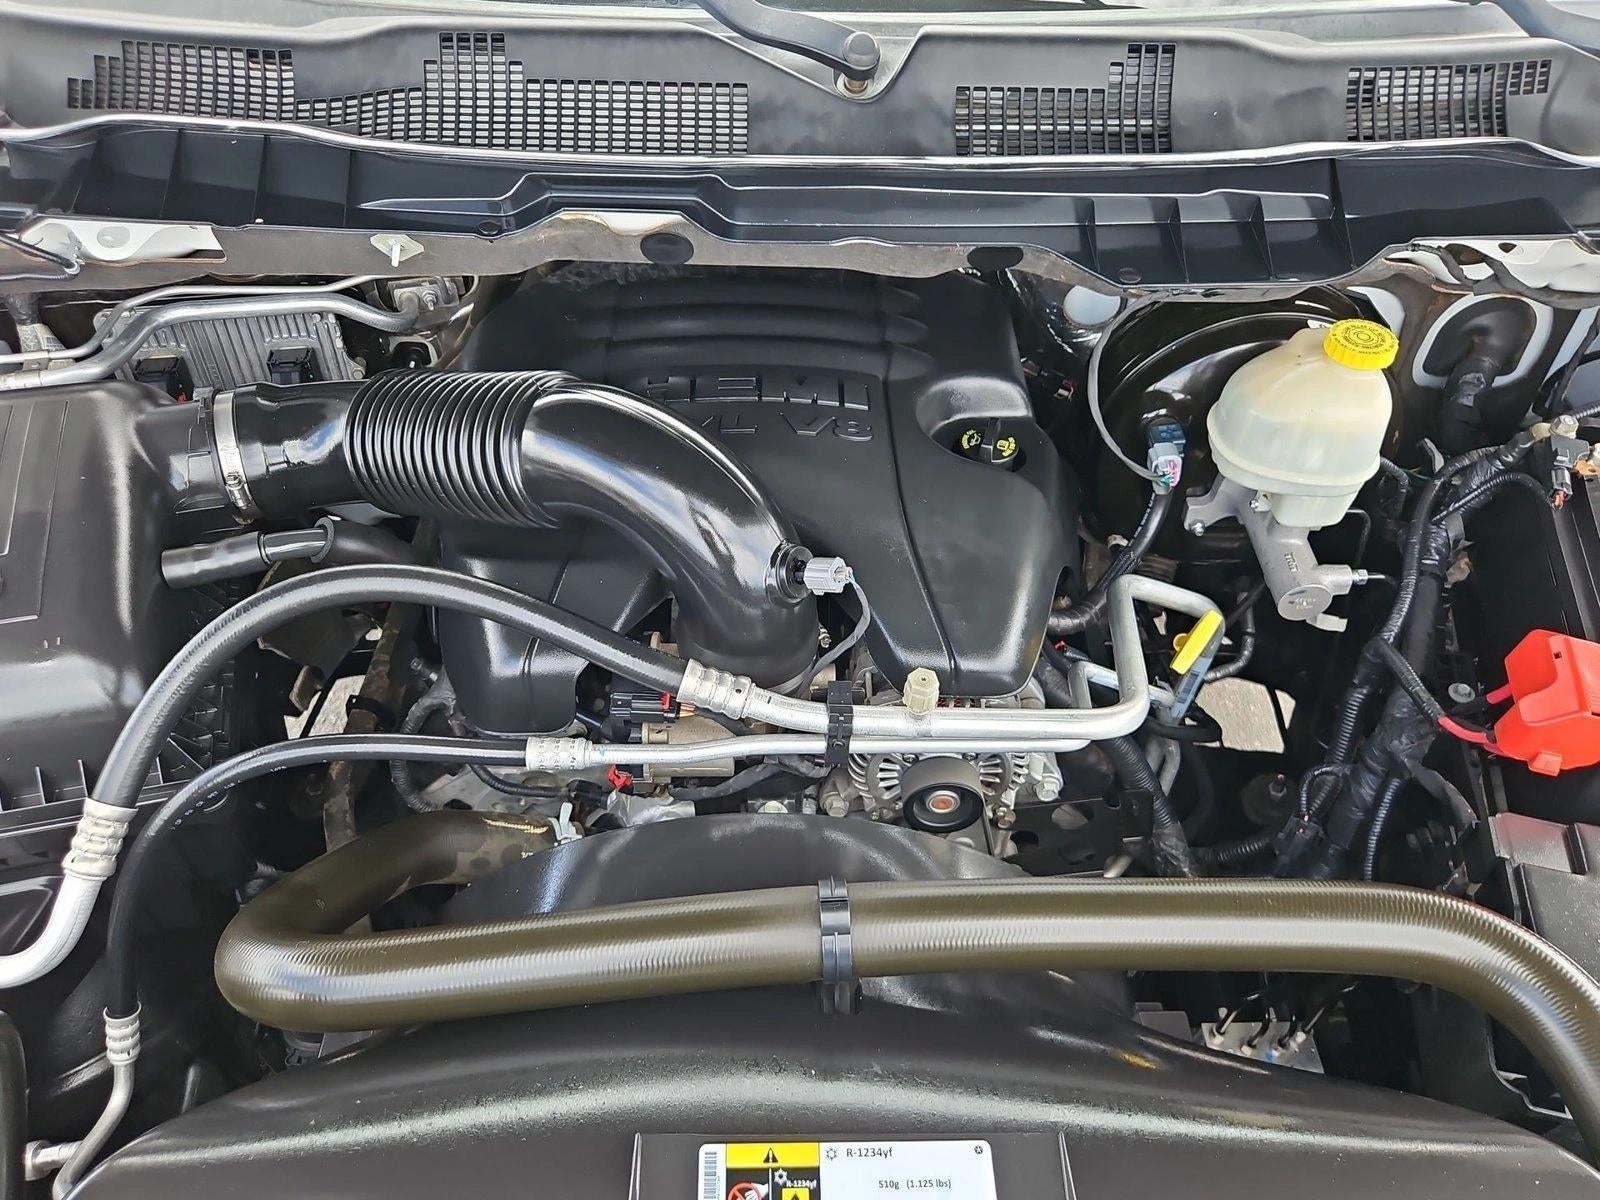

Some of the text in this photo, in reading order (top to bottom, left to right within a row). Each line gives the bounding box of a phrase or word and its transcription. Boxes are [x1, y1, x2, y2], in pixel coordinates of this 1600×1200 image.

[645, 375, 871, 411] HEMI
[777, 408, 874, 441] V8
[846, 1146, 893, 1160] R-1234yf
[785, 1179, 817, 1190] R-1234yf
[878, 1179, 952, 1190] 510g (1.125 lbs)
